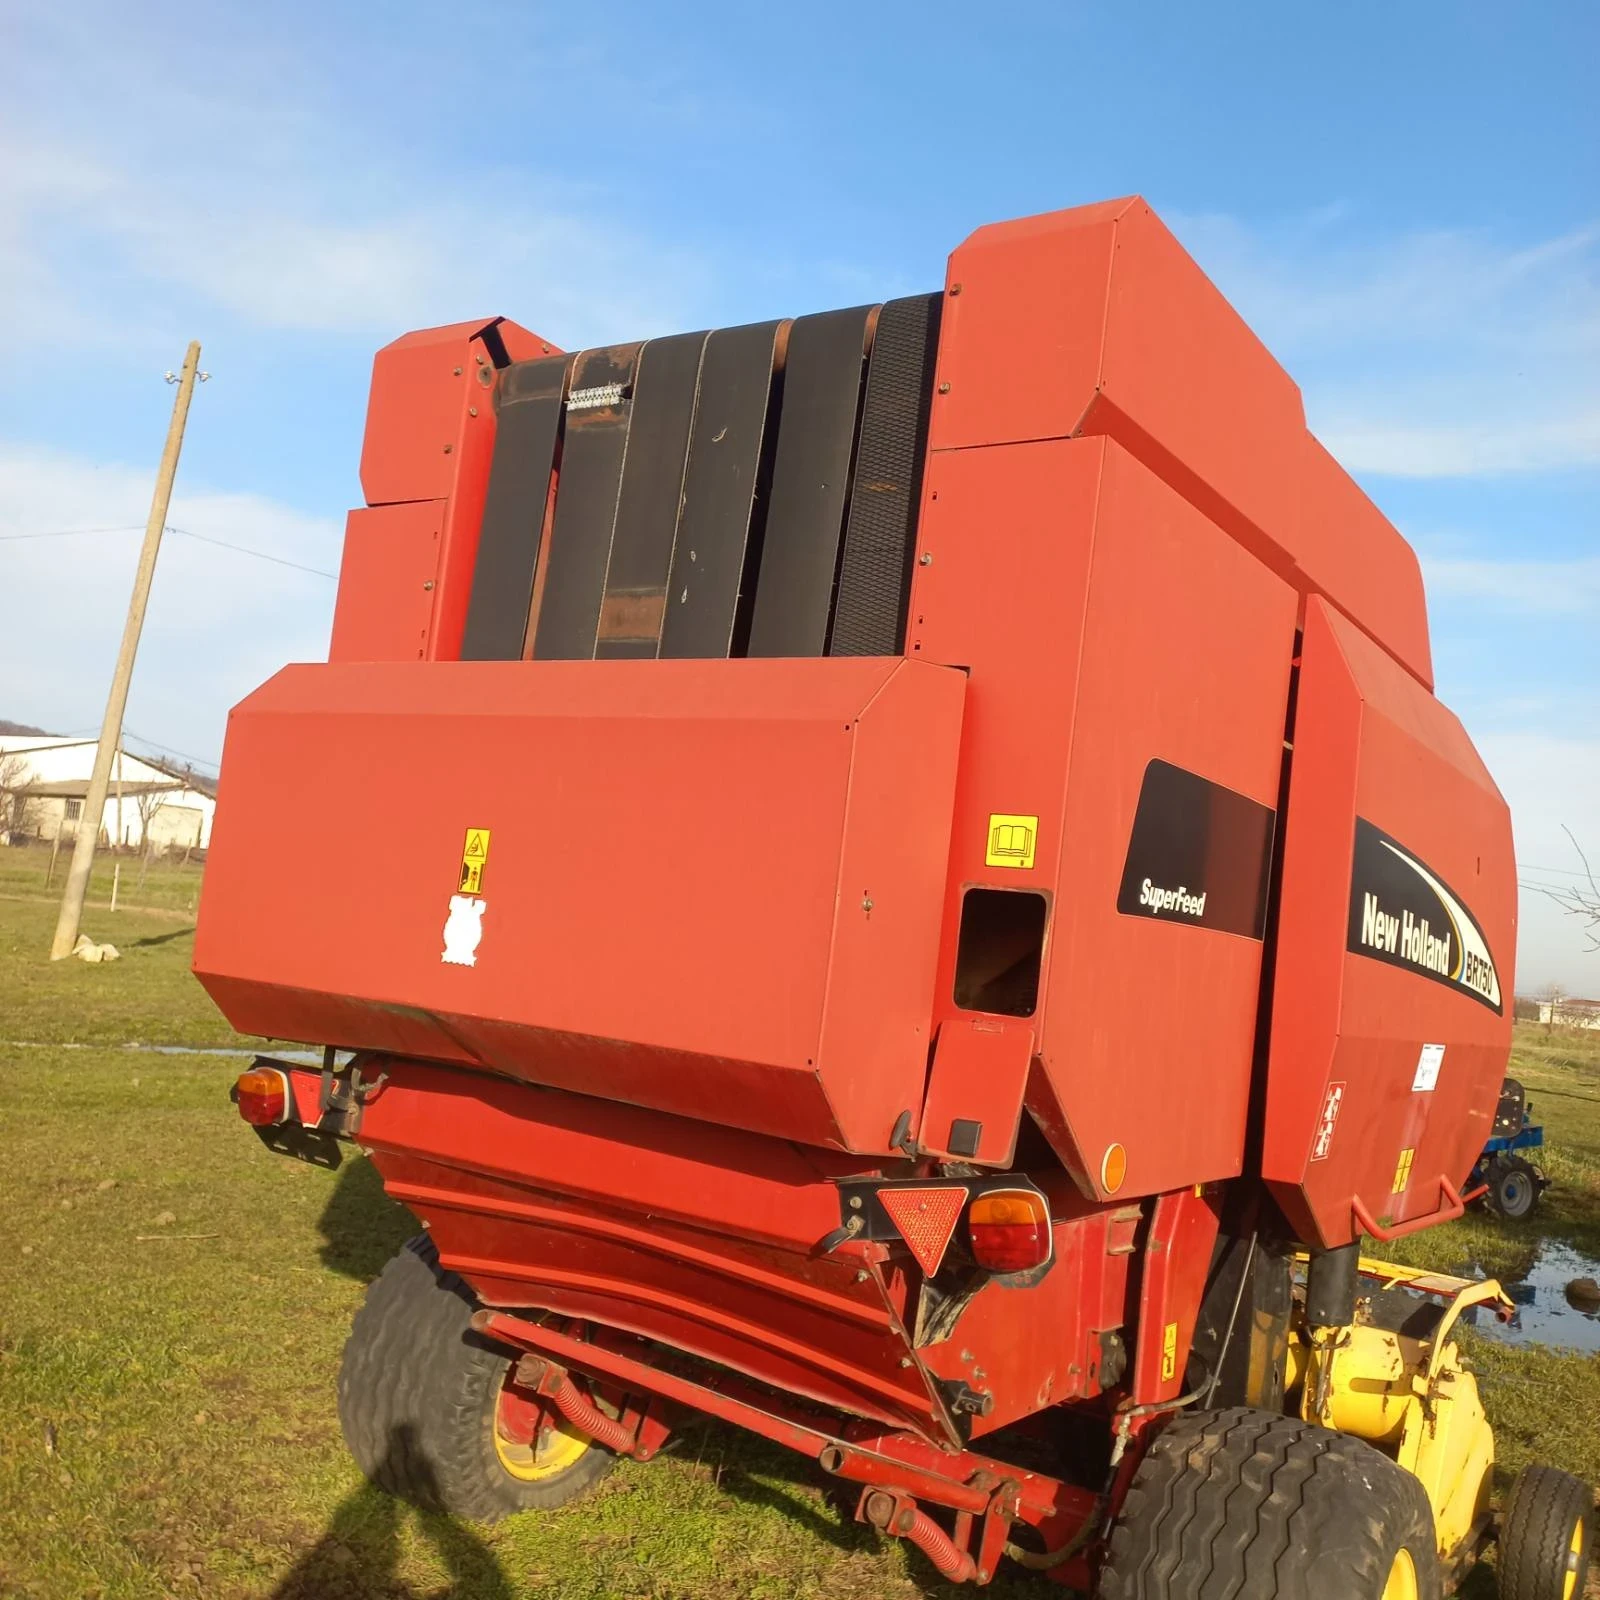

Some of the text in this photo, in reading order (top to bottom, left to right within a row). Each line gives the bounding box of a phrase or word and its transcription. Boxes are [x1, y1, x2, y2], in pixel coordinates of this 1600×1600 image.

[1140, 878, 1206, 916] SuperFeed
[1361, 892, 1451, 976] New Holland
[1466, 950, 1493, 995] BR750
